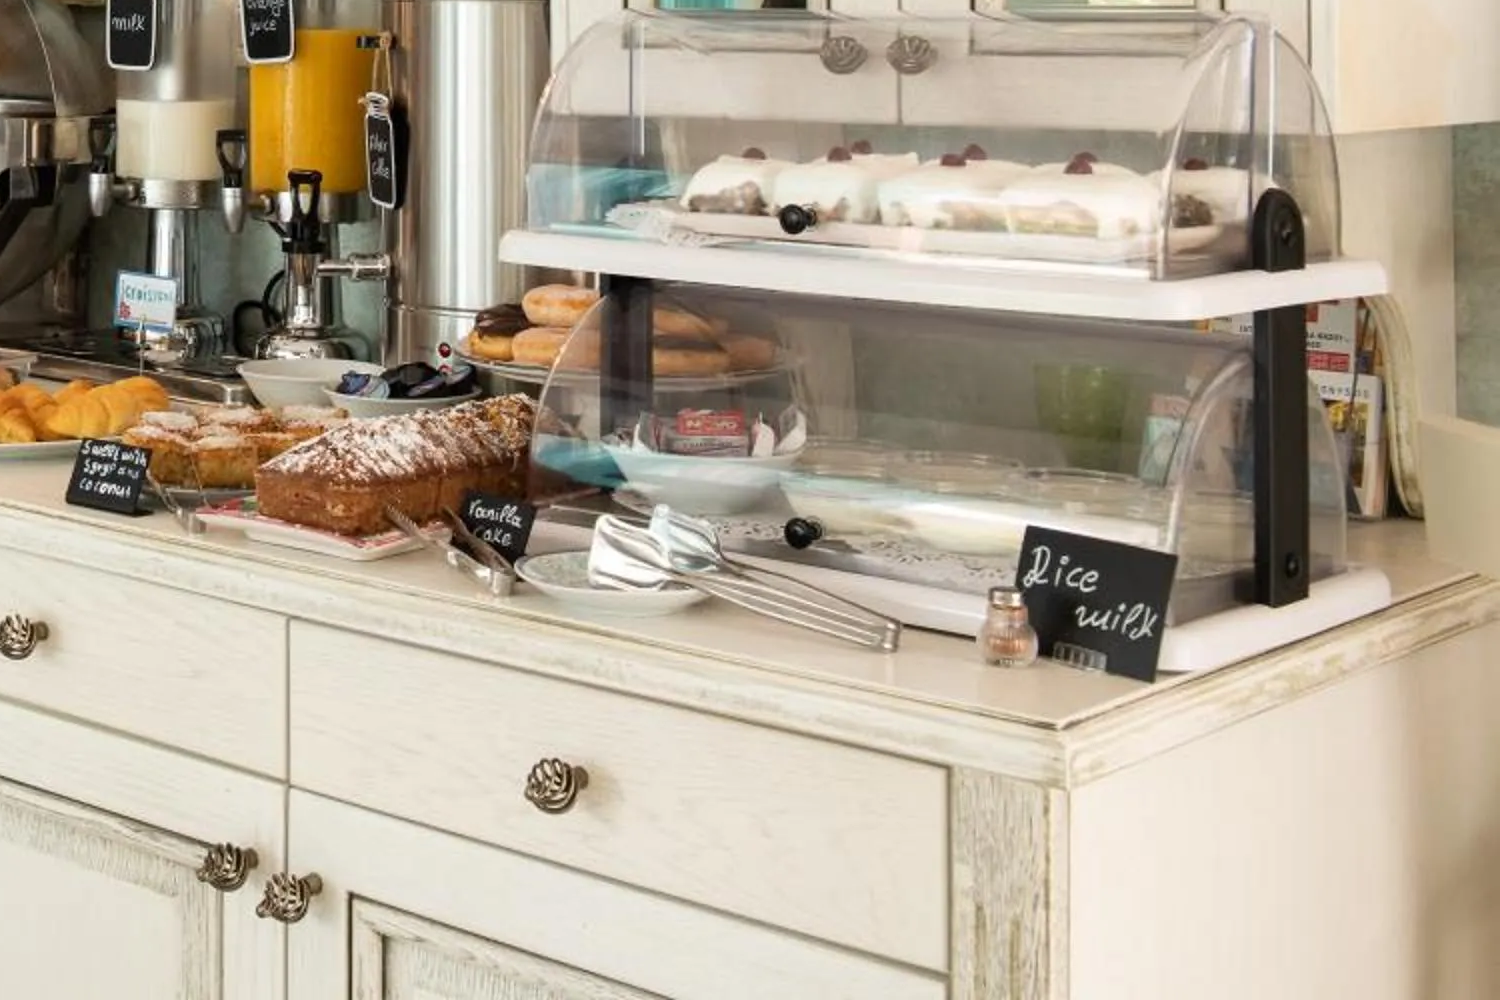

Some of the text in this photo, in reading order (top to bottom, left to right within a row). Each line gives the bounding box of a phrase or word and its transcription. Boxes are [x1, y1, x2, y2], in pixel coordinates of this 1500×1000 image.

[112, 12, 146, 33] milk
[469, 499, 523, 529] Vanilla
[1022, 545, 1100, 593] Rice
[1075, 602, 1159, 640] milk
